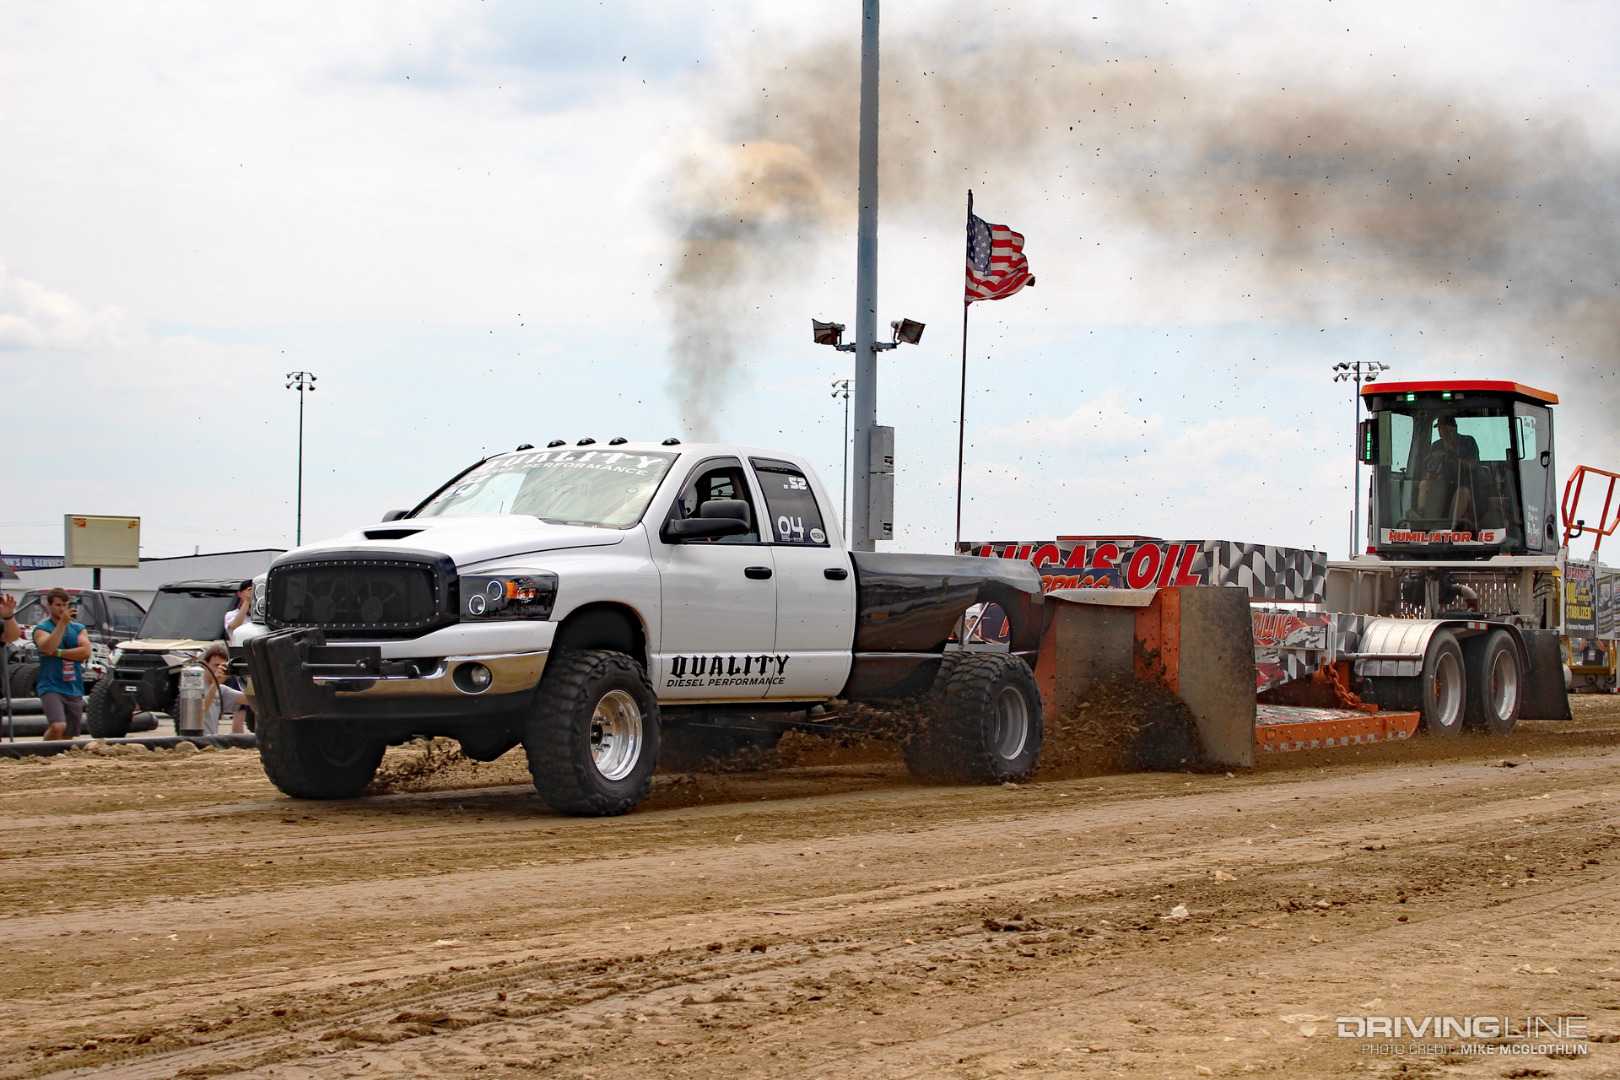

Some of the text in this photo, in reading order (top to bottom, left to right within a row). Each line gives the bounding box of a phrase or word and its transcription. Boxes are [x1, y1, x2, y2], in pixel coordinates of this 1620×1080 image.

[525, 459, 649, 476] PERFORMANCE
[778, 515, 804, 539] 04
[1388, 531, 1495, 543] HUMILIATOR 15
[21, 558, 34, 567] OIL
[34, 558, 65, 567] SERVICE
[980, 543, 1120, 569] CAS
[1126, 543, 1202, 590] OIL
[1566, 582, 1578, 604] OIL
[1566, 605, 1592, 620] STABILIZER
[669, 654, 790, 678] QUALITY
[666, 677, 785, 687] DIESEL PERFORMANCE
